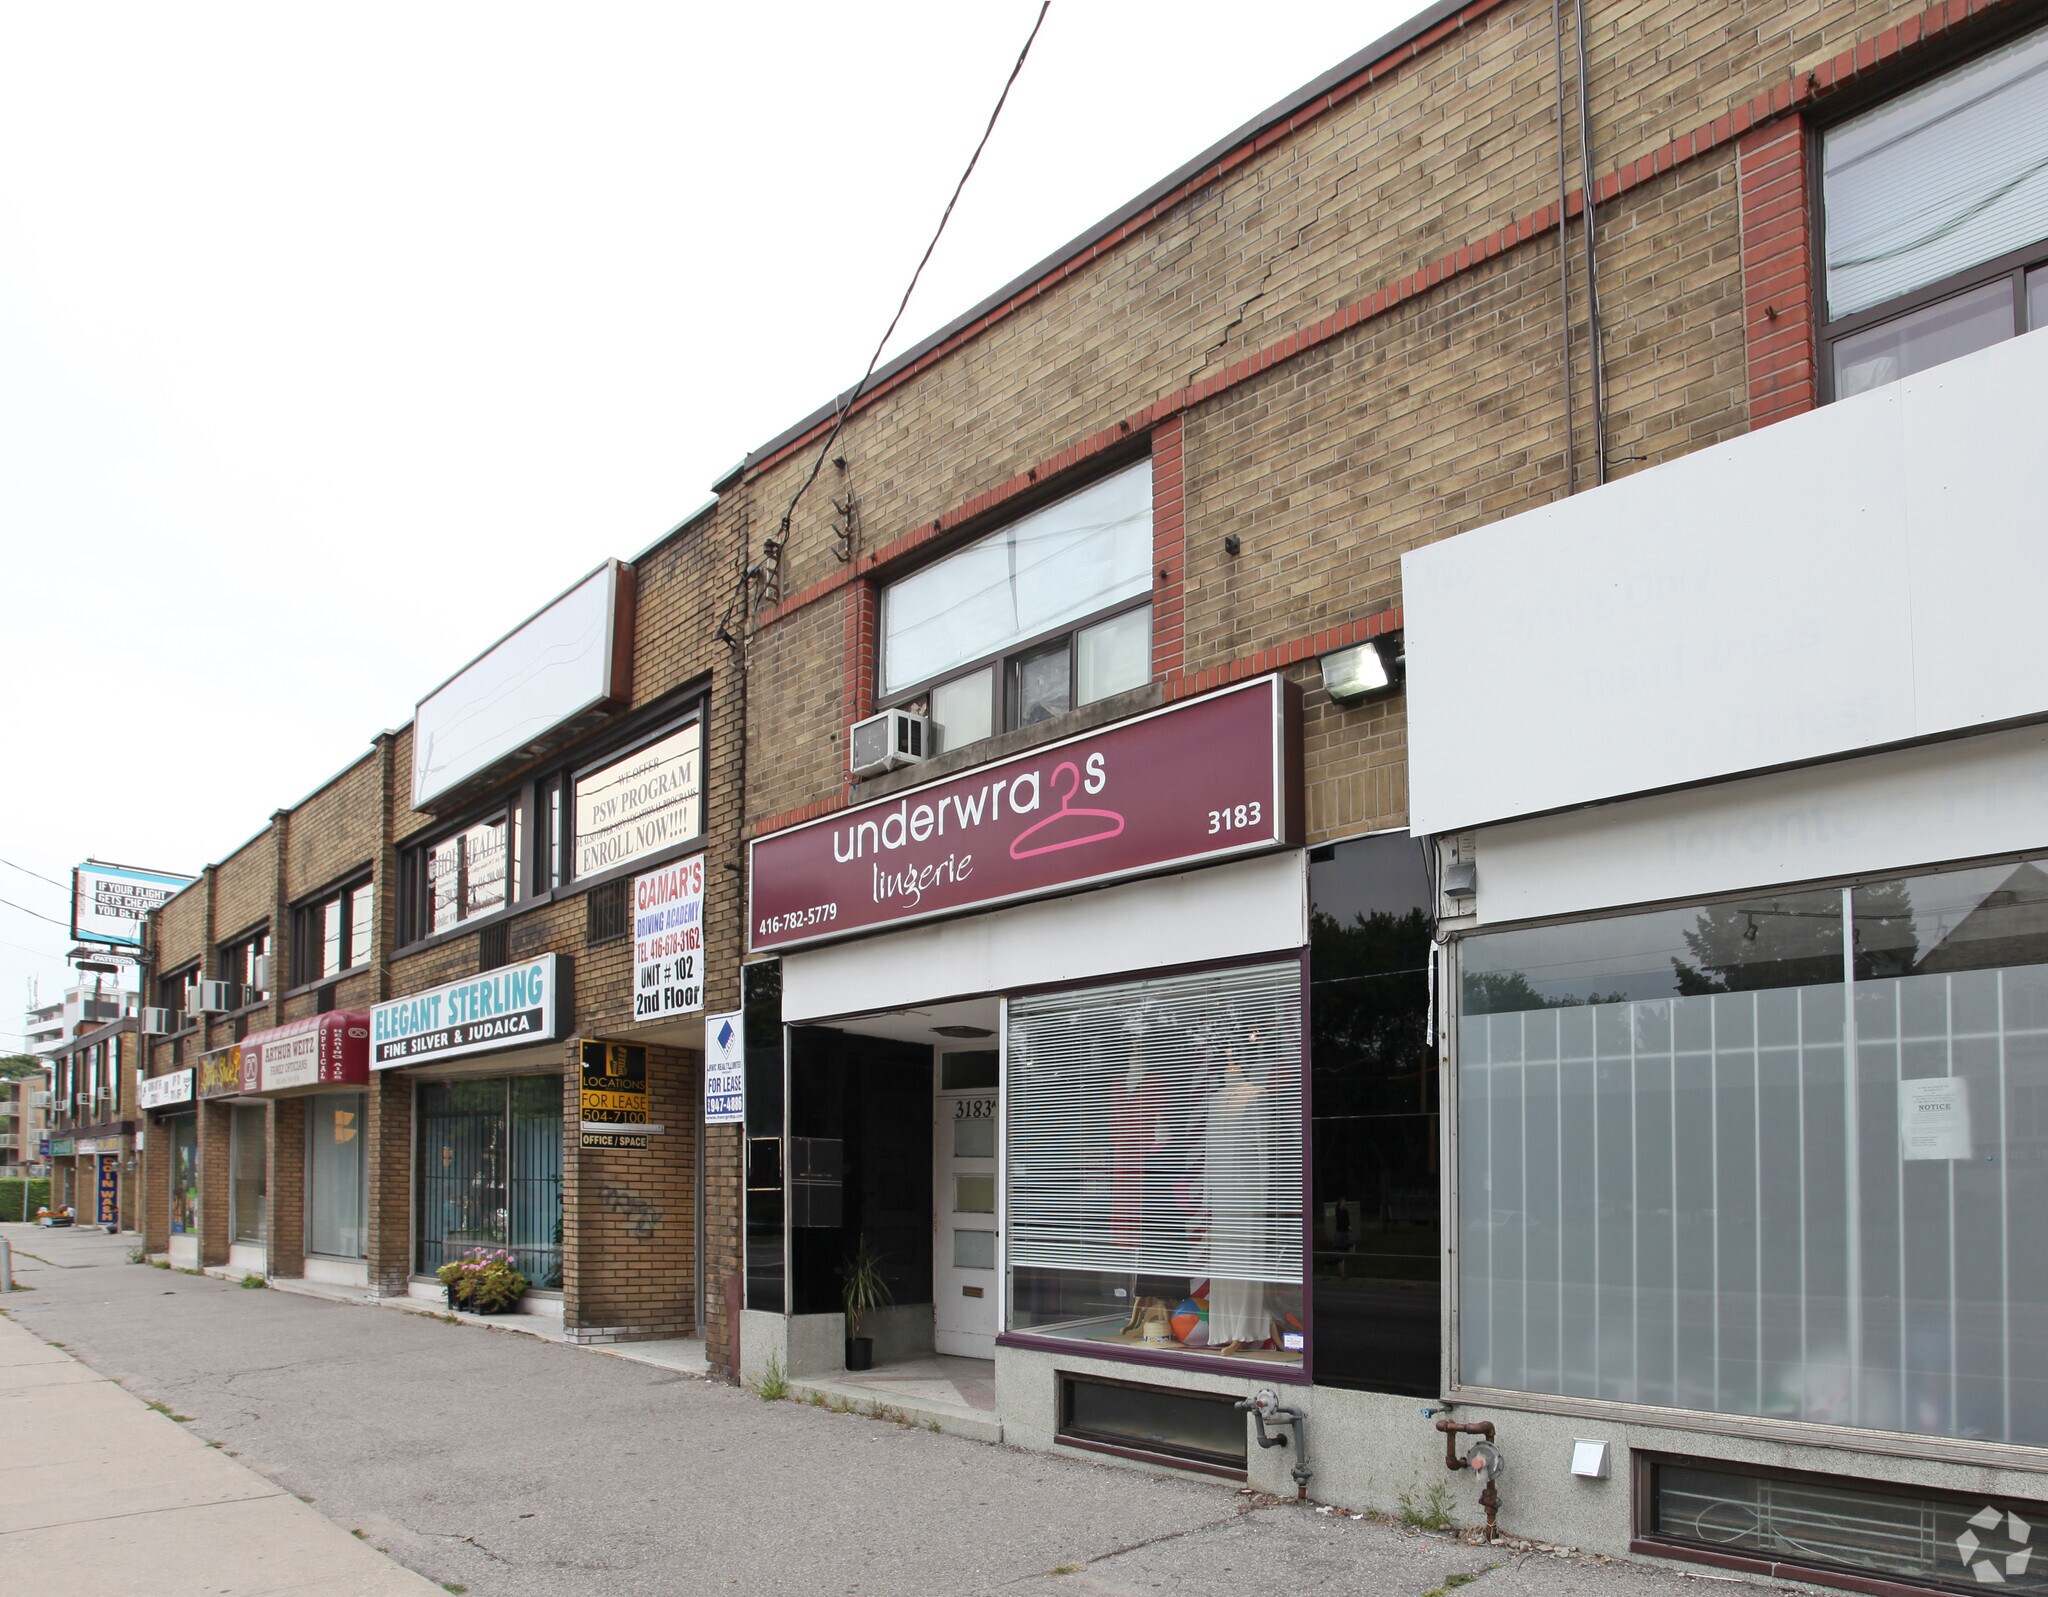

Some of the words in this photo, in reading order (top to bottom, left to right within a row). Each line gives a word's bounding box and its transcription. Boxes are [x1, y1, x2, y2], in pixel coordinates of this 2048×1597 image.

[618, 771, 631, 787] WE
[633, 757, 660, 780] OFFER
[592, 796, 619, 825] PSW
[621, 761, 692, 813] PROGRAM
[1207, 800, 1262, 835] 3183
[583, 830, 634, 872] ENROLL
[636, 806, 687, 851] NOW!!!!
[98, 881, 108, 892] IF
[109, 883, 134, 896] YOUR
[135, 887, 167, 900] FLIGHT
[638, 861, 702, 911] QAMAR'S
[872, 852, 974, 909] lingerie
[98, 894, 122, 905] GETS
[124, 897, 164, 910] CHEAPE
[98, 905, 117, 917] YOU
[118, 908, 137, 919] GET
[637, 911, 664, 938] DRIVING
[666, 901, 701, 930] ACADEMY
[759, 902, 838, 936] 416-782-5779
[650, 926, 701, 960] 416-678-3162
[94, 955, 133, 965] PATTISON
[641, 963, 661, 989] UNIT
[664, 962, 672, 984] #
[674, 955, 694, 981] 102
[376, 994, 442, 1041] ELEGANT
[448, 965, 543, 1025] STERLING
[636, 989, 660, 1015] 2nd
[664, 984, 701, 1010] Floor
[265, 1042, 292, 1063] ARTHUR
[293, 1037, 315, 1057] WEITZ
[333, 1028, 342, 1059] HEARING
[383, 1039, 407, 1059] FINE
[411, 1032, 449, 1051] SILVER
[454, 1029, 463, 1044] &
[468, 1015, 530, 1041] JUDAICA
[583, 1076, 645, 1090] LOCATIONS
[708, 1077, 721, 1093] FOR
[723, 1075, 742, 1092] LEASE
[581, 1093, 610, 1108] FOR
[612, 1095, 647, 1110] LEASE
[583, 1109, 645, 1124] 504-7100
[1918, 1103, 1951, 1111] NOTICE
[583, 1135, 613, 1146] OFFICE
[619, 1136, 647, 1148] SPACE
[102, 1157, 114, 1188] COIN
[101, 1190, 114, 1221] WASH
